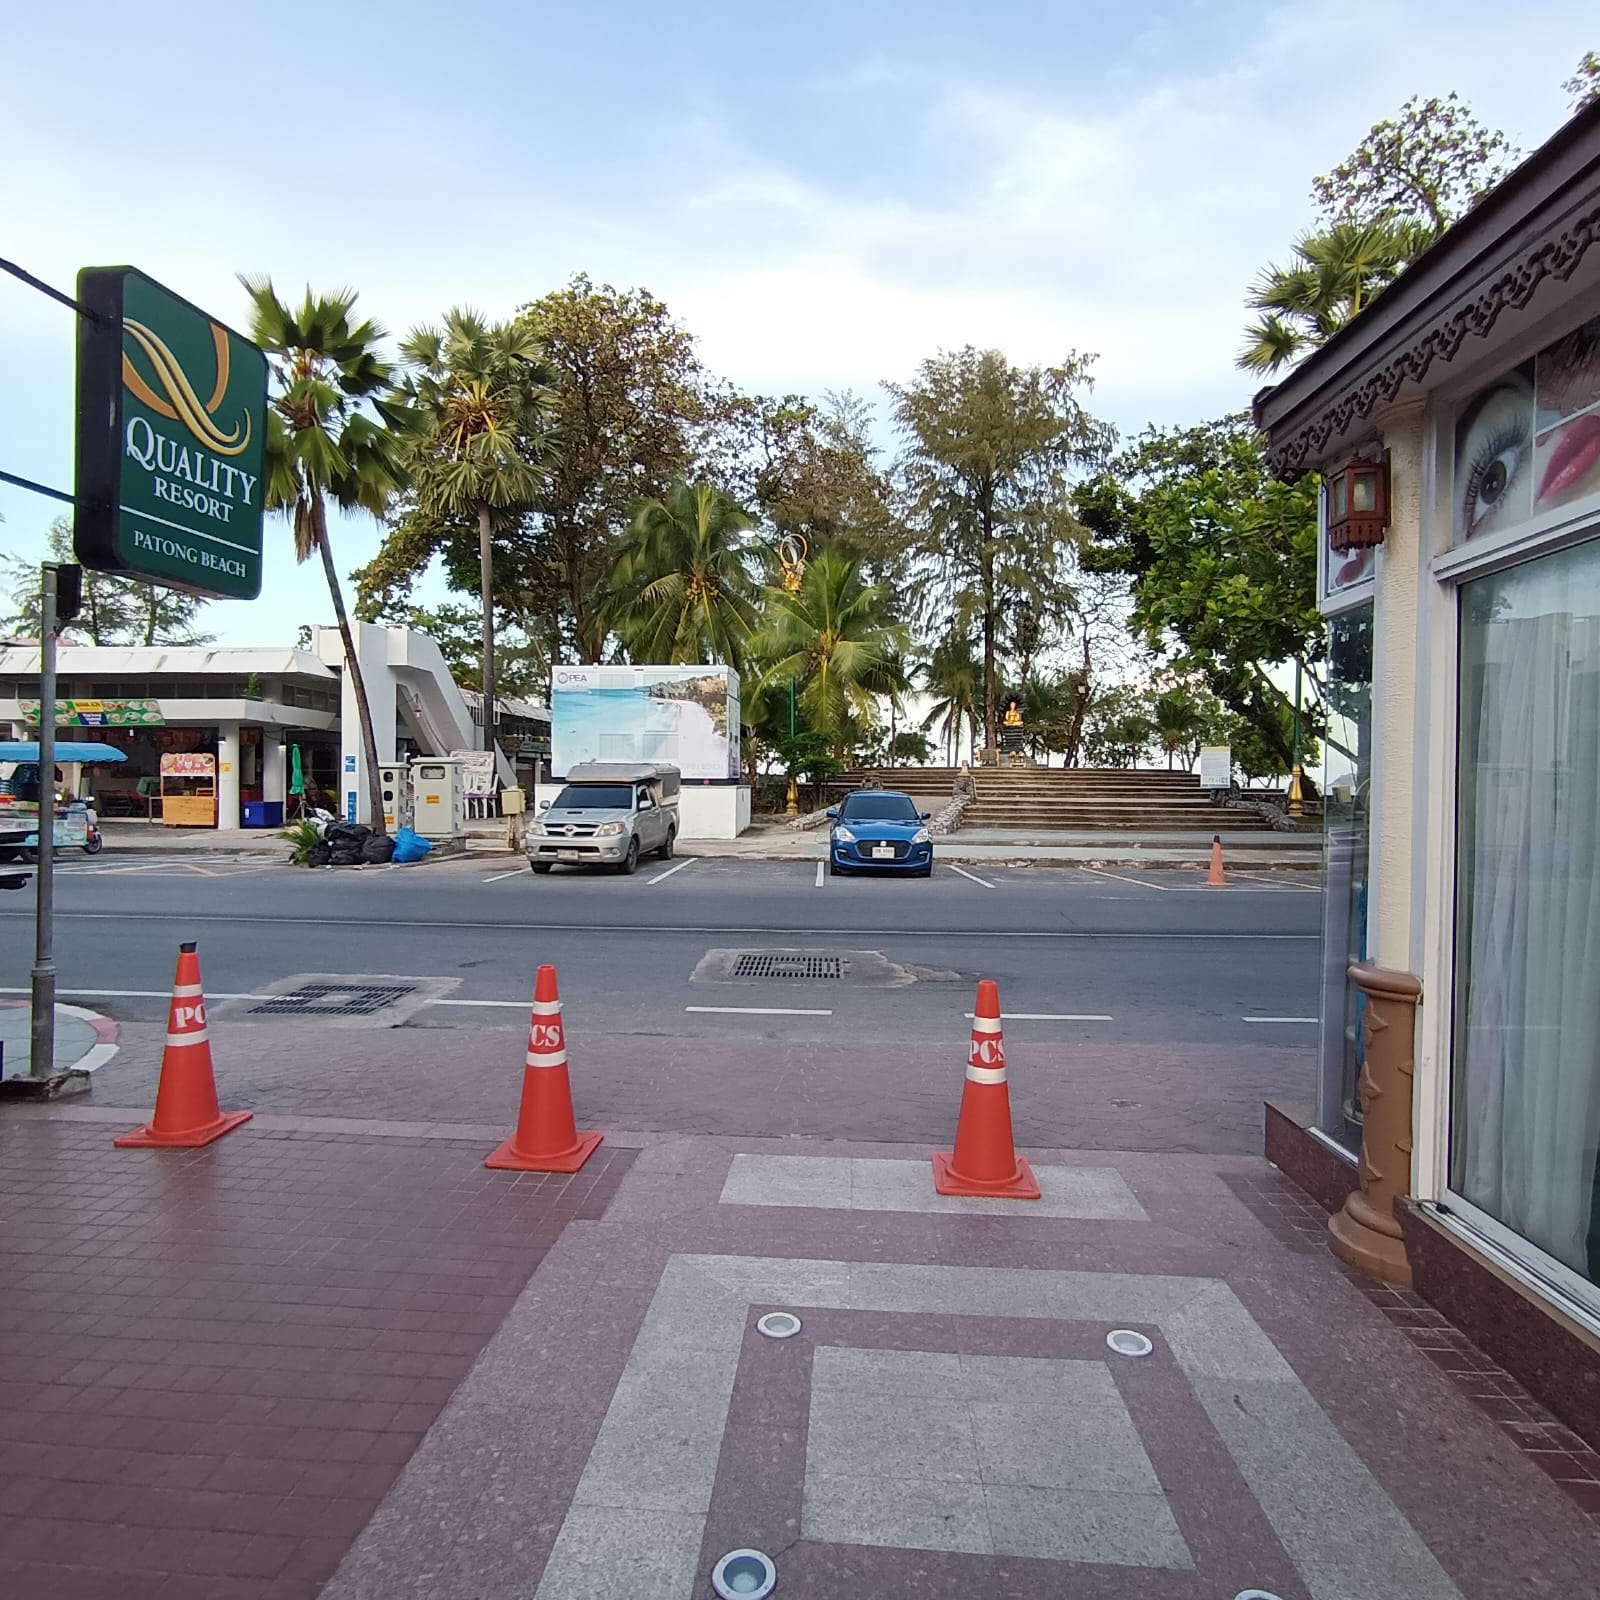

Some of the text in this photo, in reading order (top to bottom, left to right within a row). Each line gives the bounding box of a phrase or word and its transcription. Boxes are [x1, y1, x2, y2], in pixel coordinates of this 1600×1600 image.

[126, 416, 257, 505] QUALITY
[153, 476, 234, 523] RESORT
[133, 530, 247, 578] PATONG BEACH
[569, 674, 588, 682] PEA
